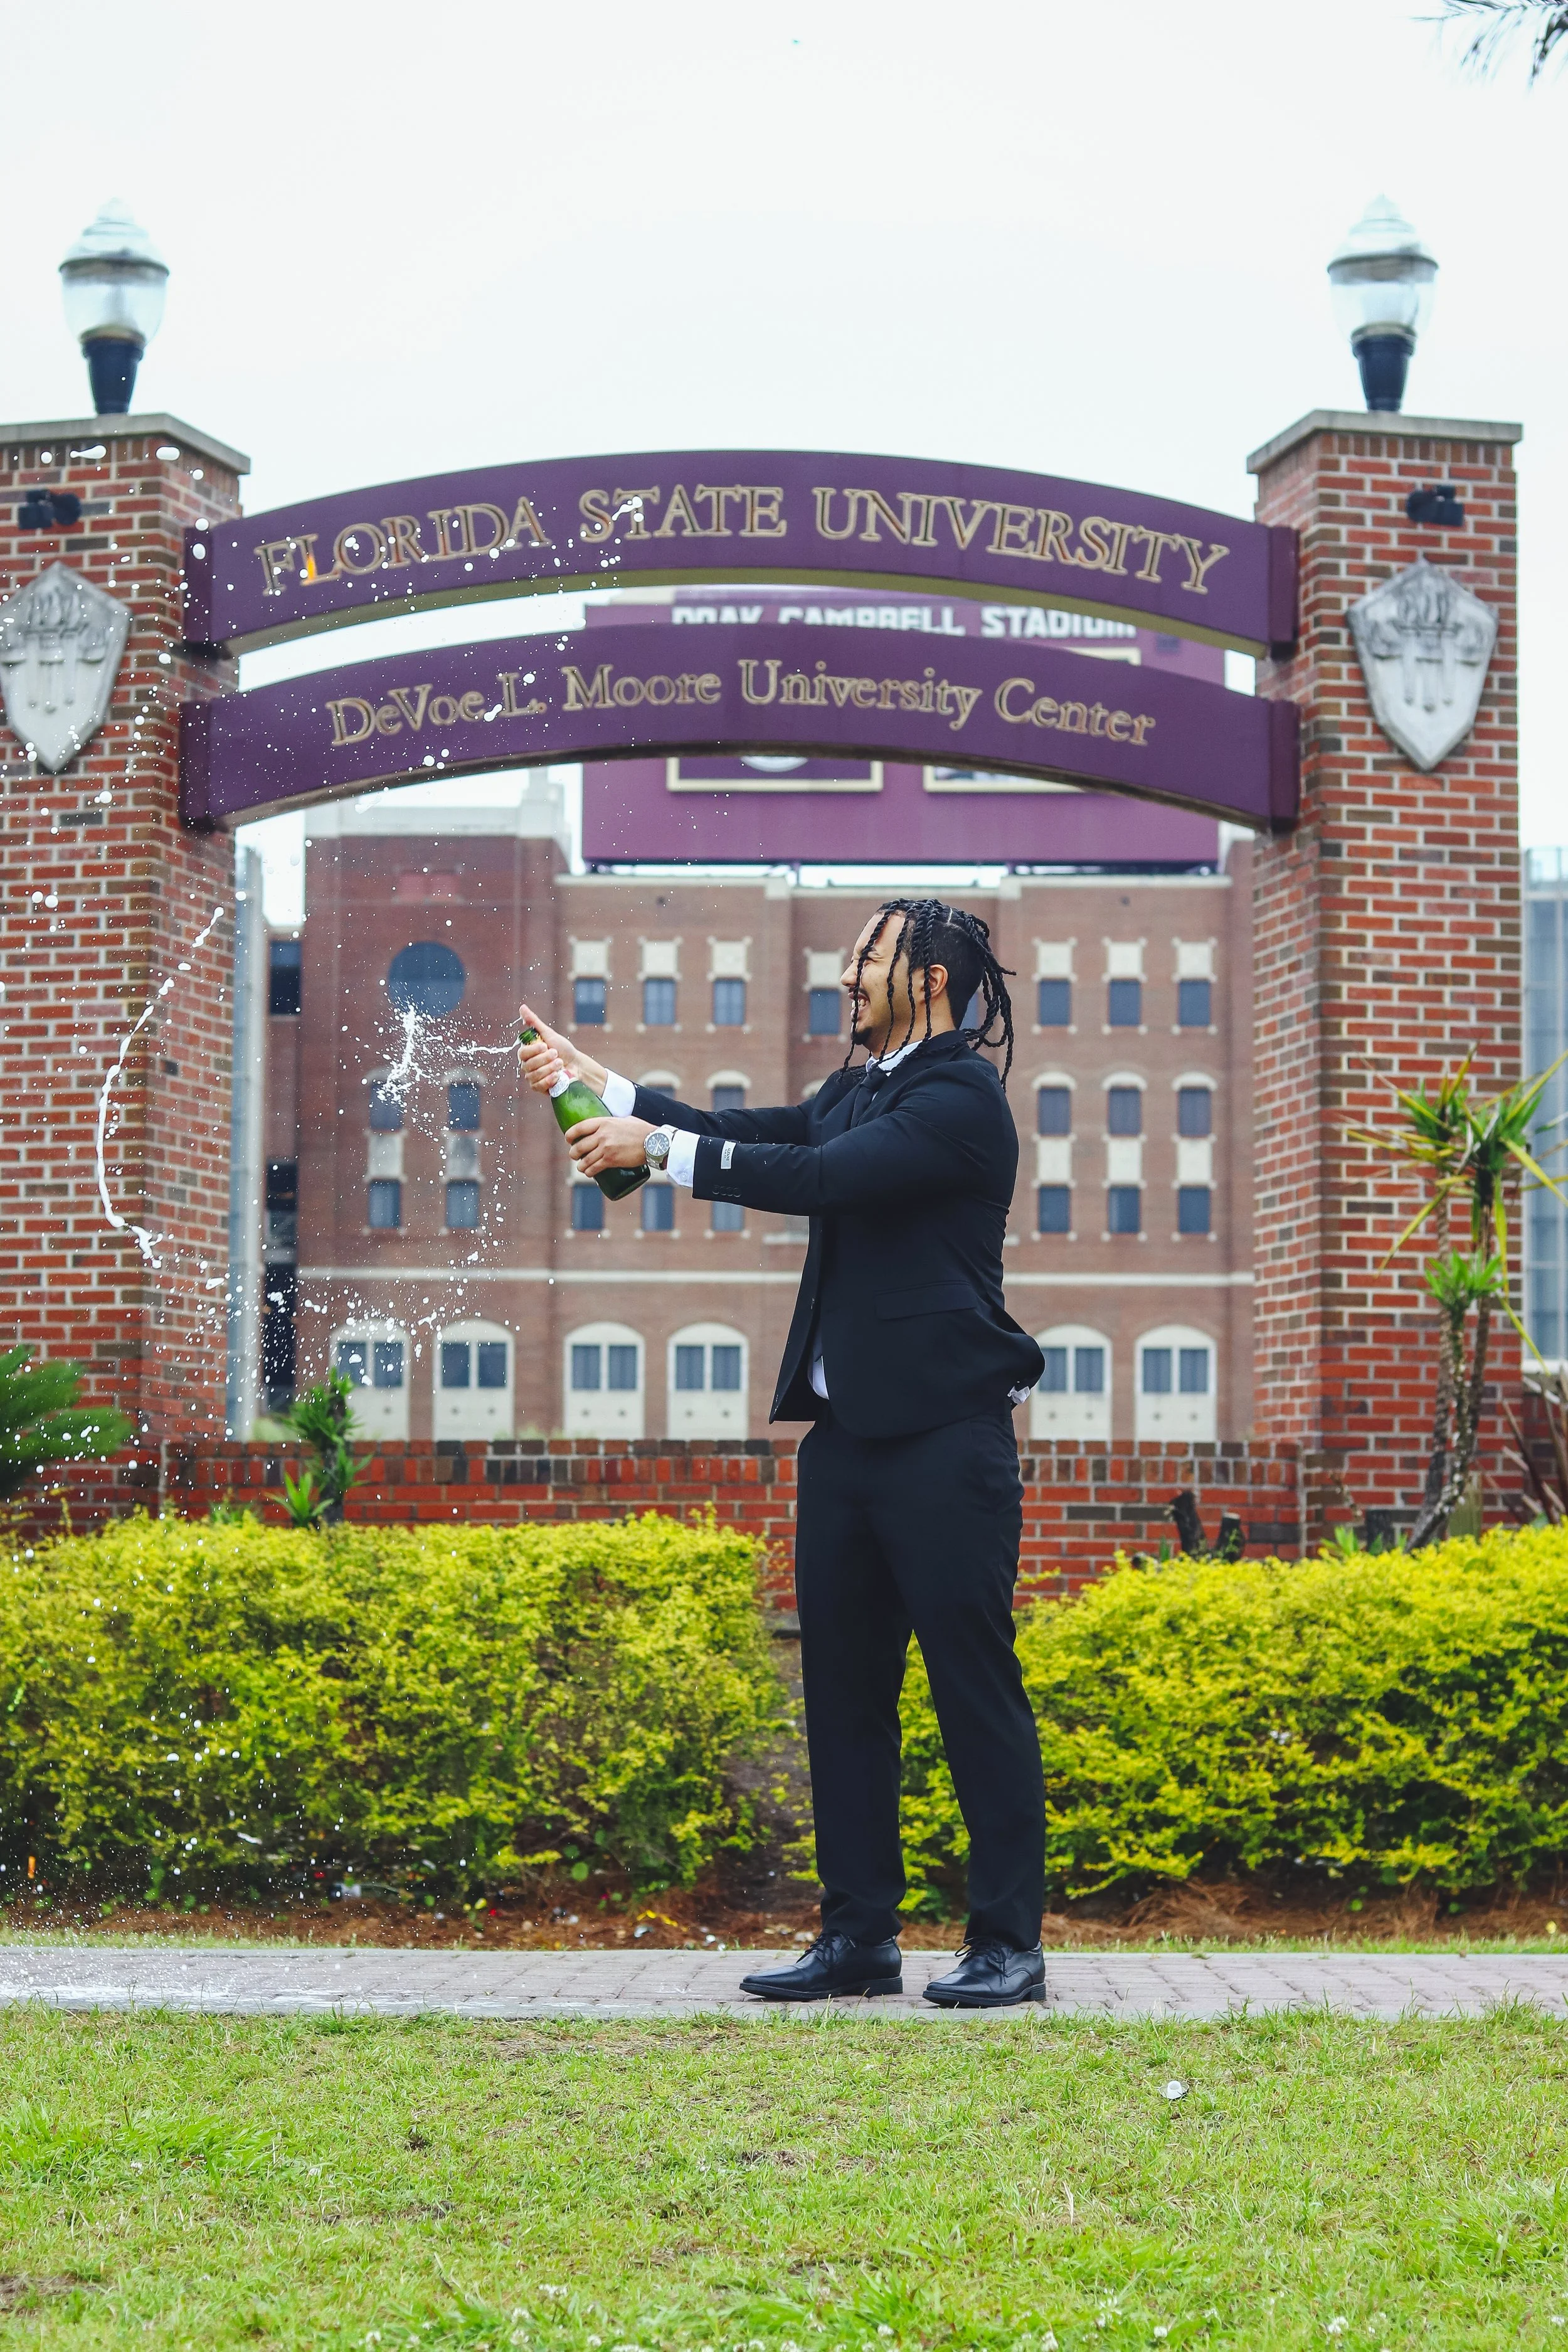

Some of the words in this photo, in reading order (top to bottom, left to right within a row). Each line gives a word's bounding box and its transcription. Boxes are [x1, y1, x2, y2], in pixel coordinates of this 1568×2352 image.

[253, 497, 552, 596] FLORIDA
[579, 484, 787, 543] STATE
[812, 485, 1230, 595] UNIVERSITY
[326, 683, 486, 746] DeVoe
[496, 672, 547, 719] L.
[561, 664, 723, 711] Moore
[737, 659, 983, 731] University
[993, 677, 1157, 746] Center
